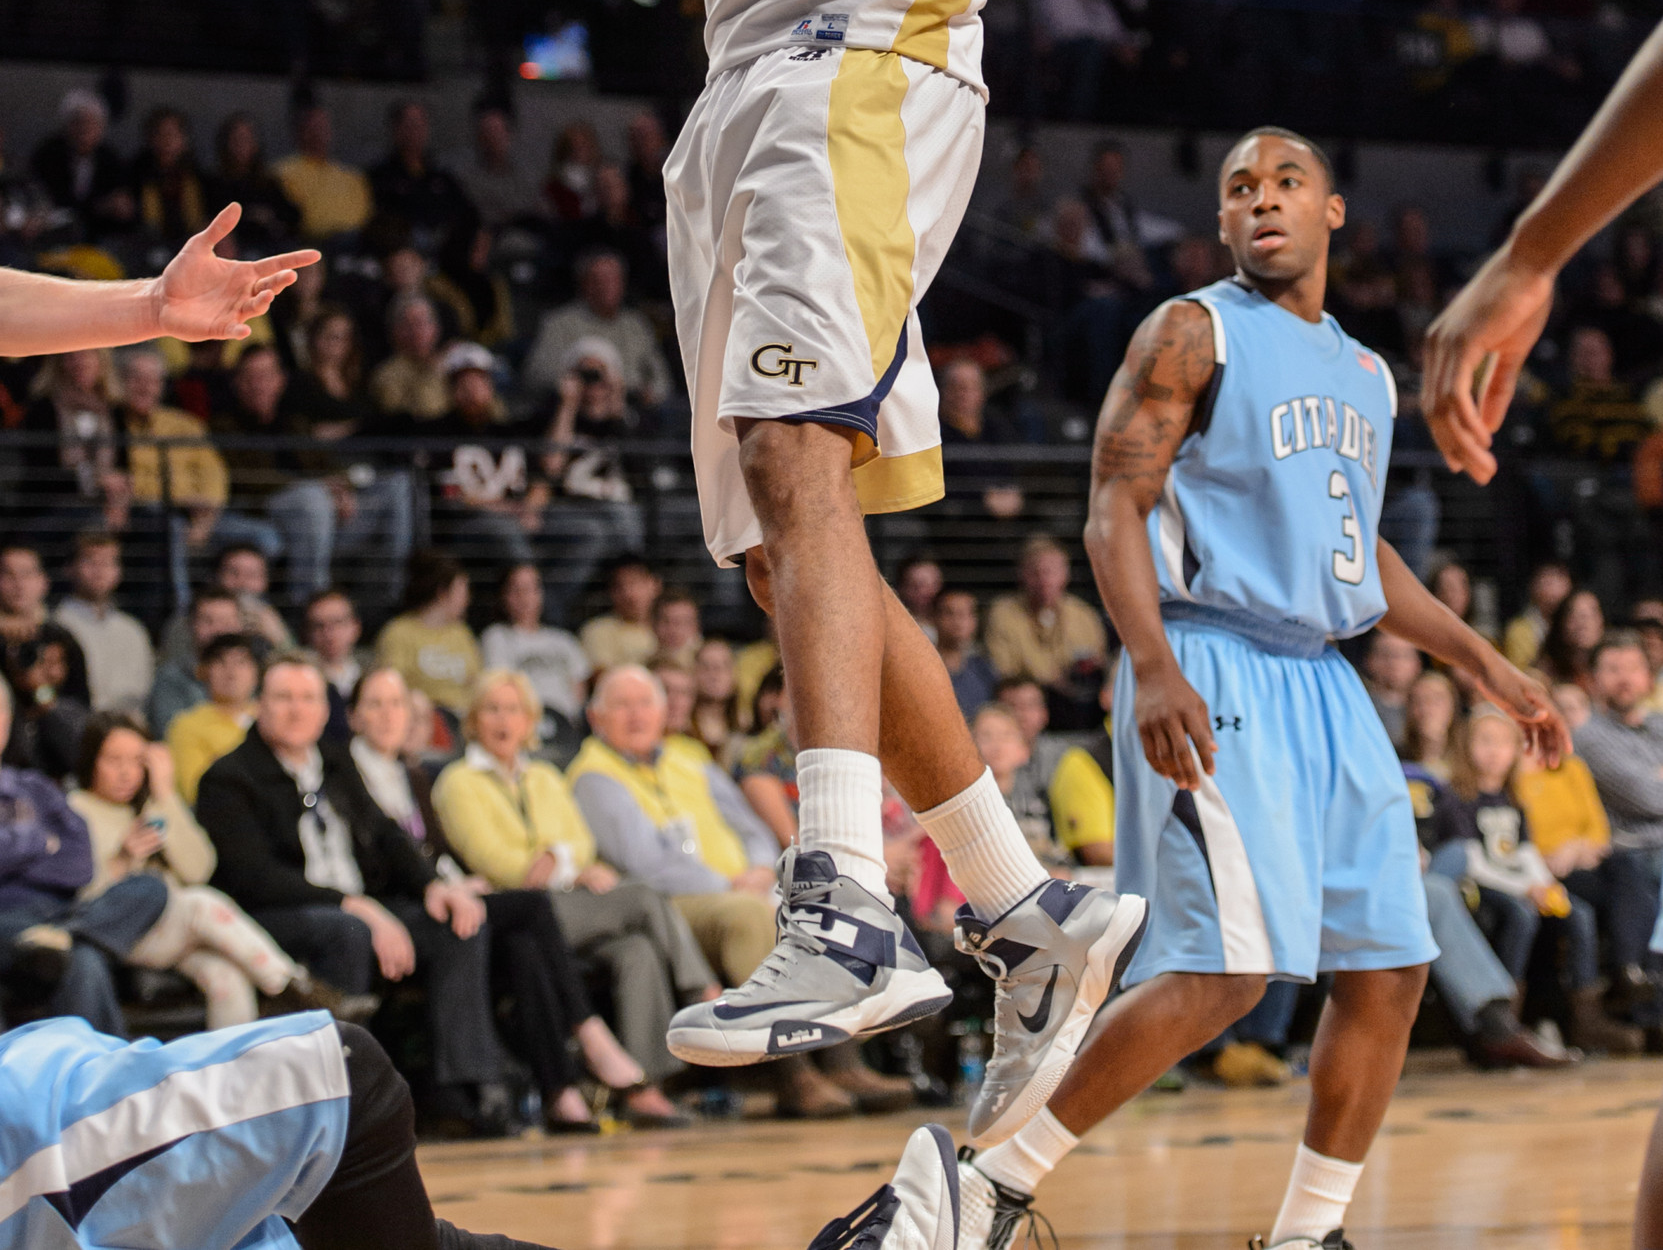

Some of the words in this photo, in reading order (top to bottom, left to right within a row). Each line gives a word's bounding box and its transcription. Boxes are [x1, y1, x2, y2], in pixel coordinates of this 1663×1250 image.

[750, 342, 818, 387] GT
[1270, 396, 1377, 491] CITADE
[1329, 470, 1366, 586] 3
